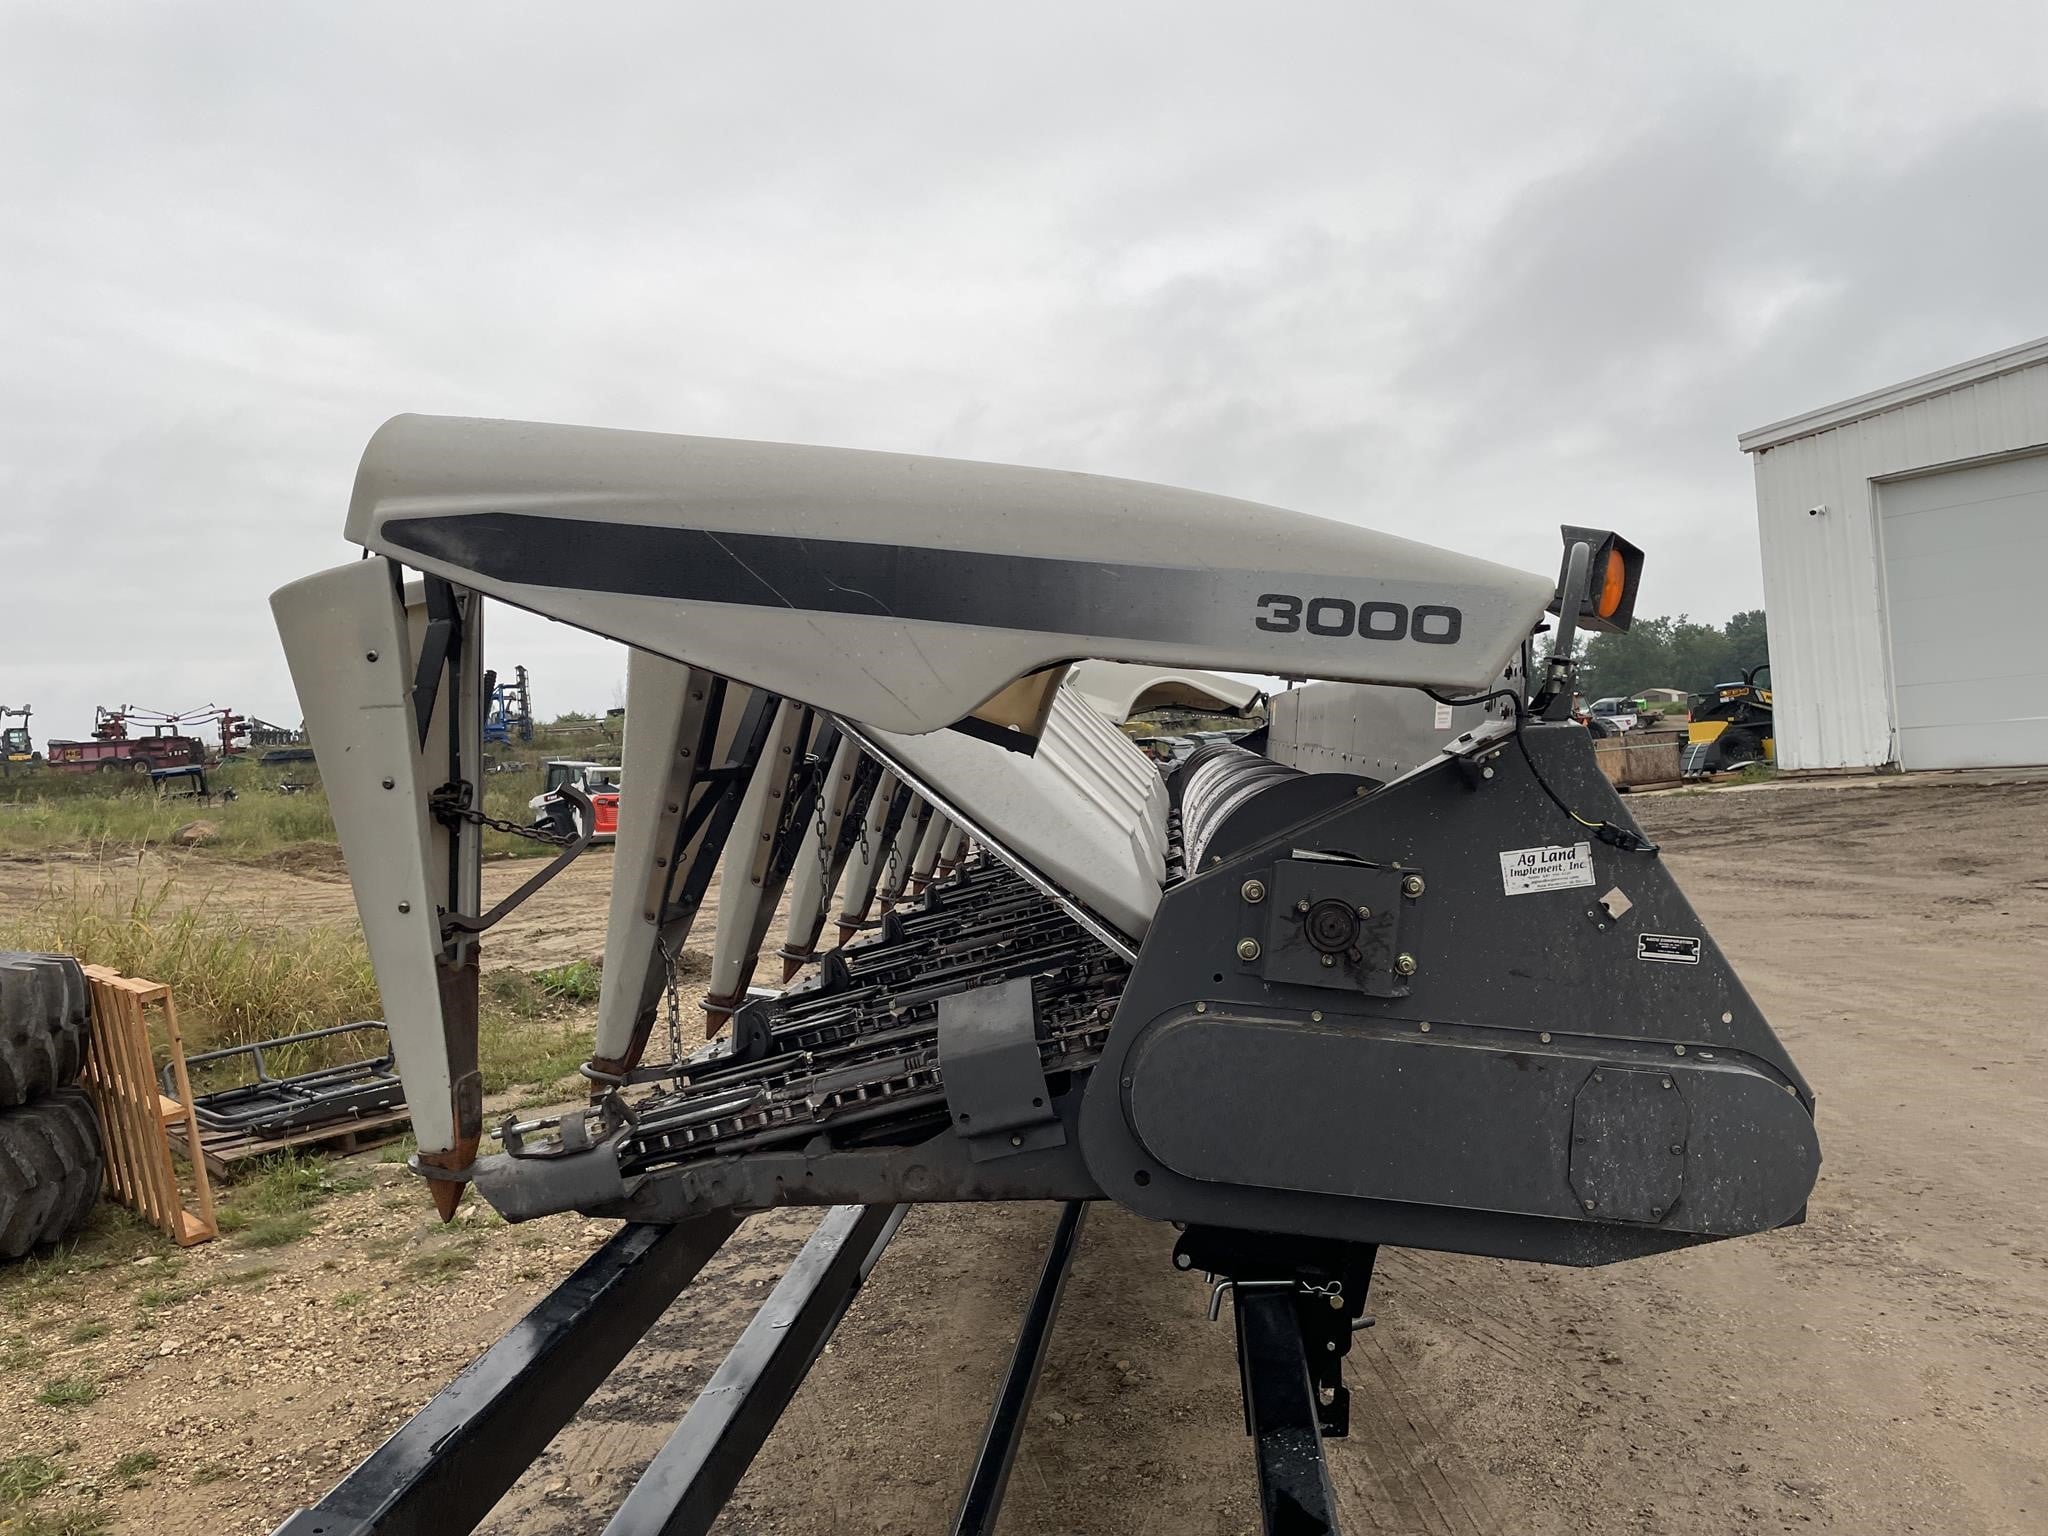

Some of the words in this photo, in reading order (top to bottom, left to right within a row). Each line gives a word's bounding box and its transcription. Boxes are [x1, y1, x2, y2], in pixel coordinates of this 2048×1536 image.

[1255, 593, 1462, 645] 3000
[1517, 854, 1536, 867] Ag
[1541, 848, 1576, 863] Land
[1510, 863, 1566, 877] Implement,
